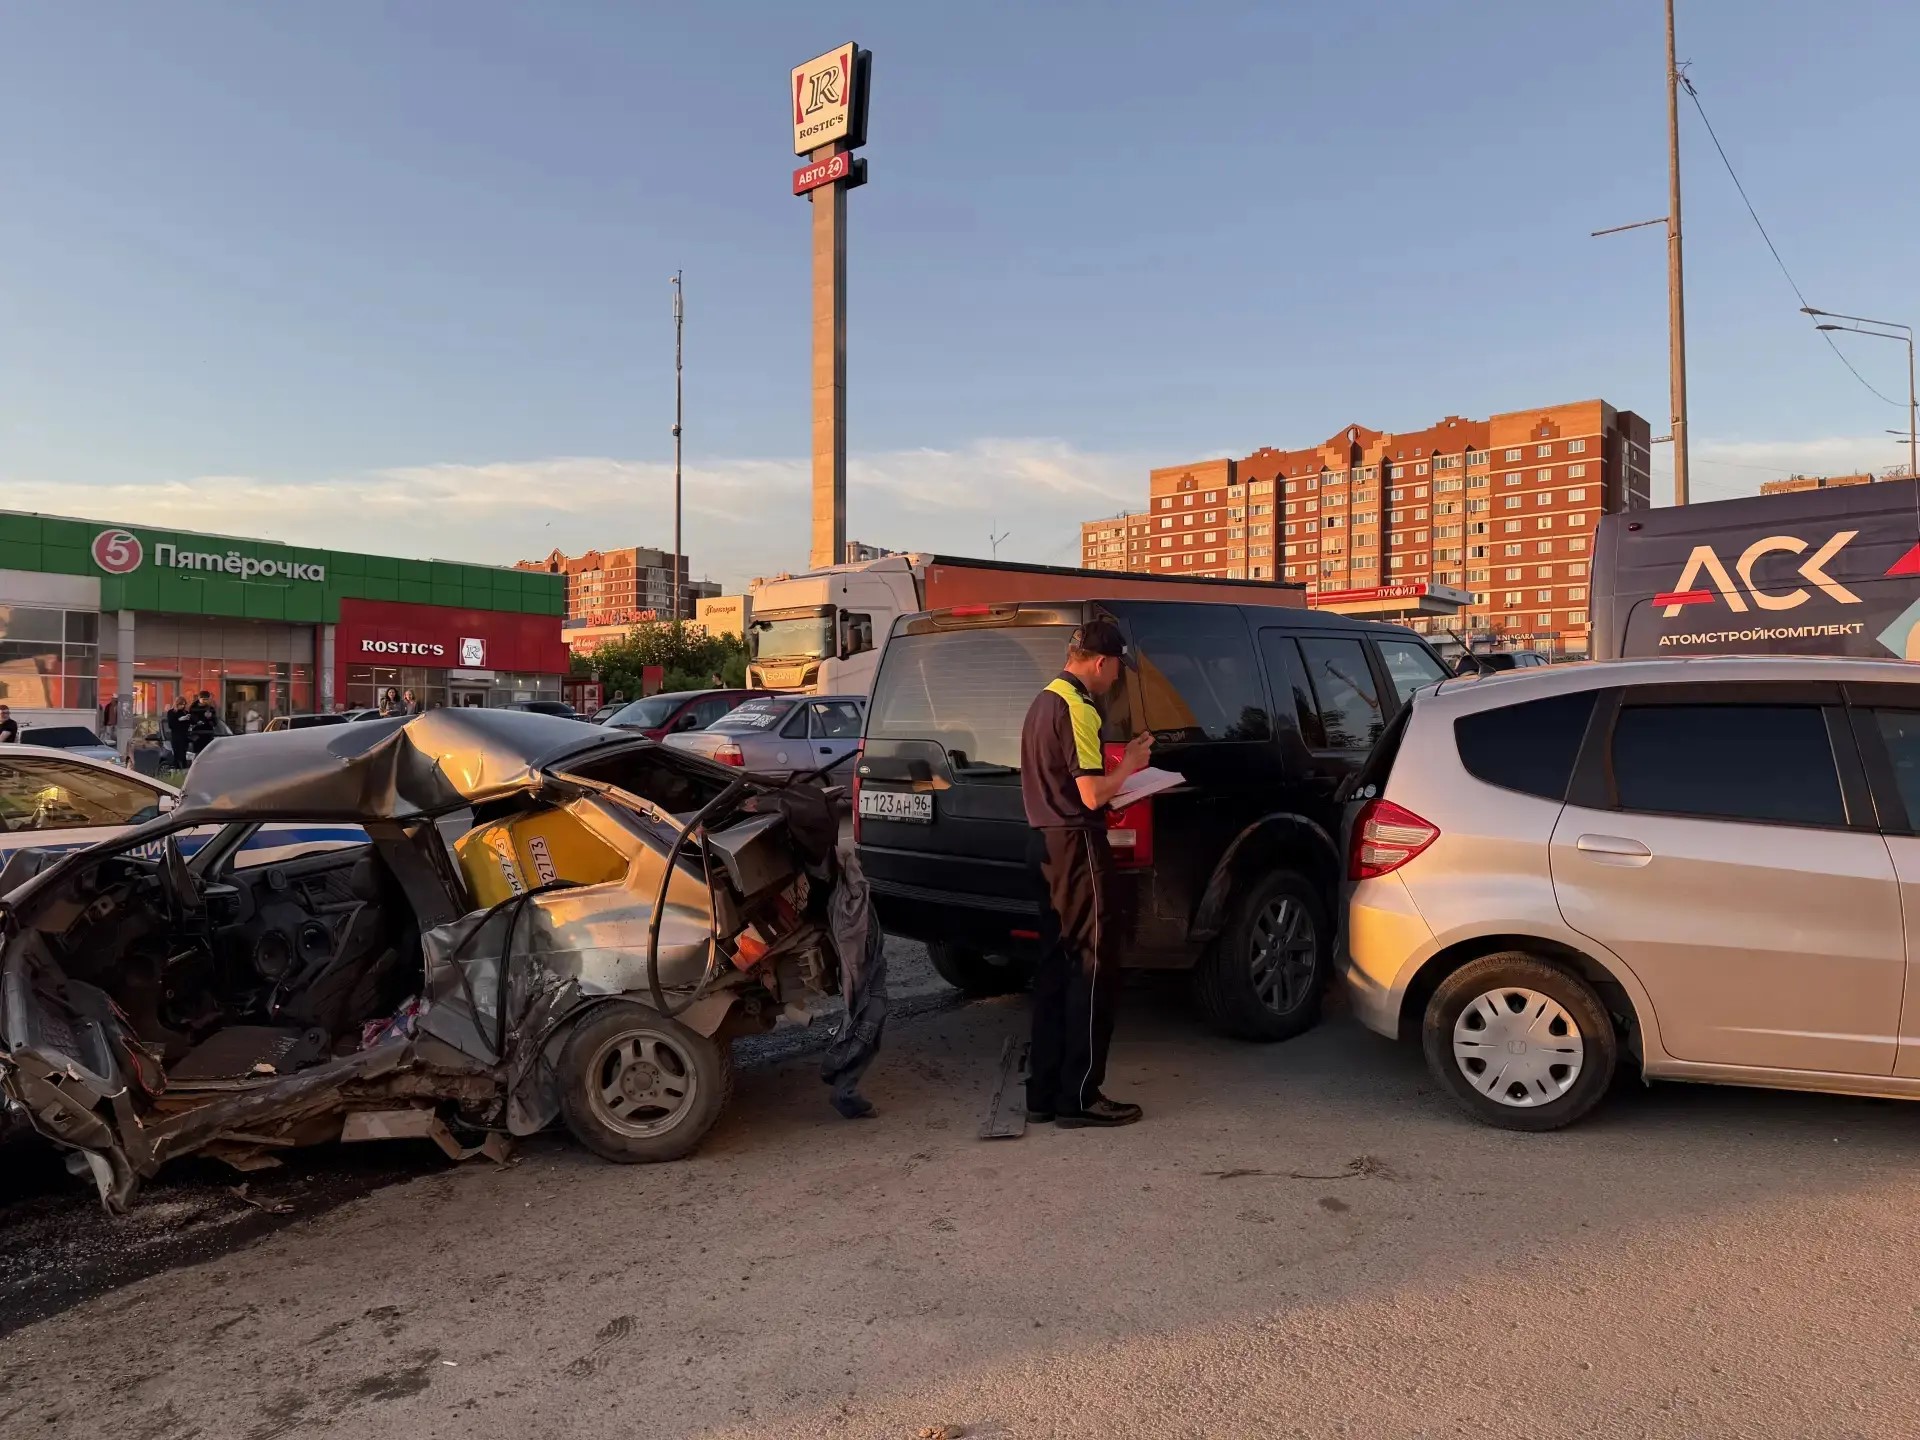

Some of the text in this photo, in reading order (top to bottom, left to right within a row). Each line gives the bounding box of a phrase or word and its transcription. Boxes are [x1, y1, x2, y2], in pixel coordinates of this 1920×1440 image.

[800, 114, 844, 139] ROSTIC'S
[798, 161, 840, 186] АВТО 24
[154, 543, 325, 582] Пятёрочка
[1652, 530, 1863, 618] АСК
[1376, 585, 1416, 597] ЛУКОЙЛ
[1659, 623, 1865, 646] АТОМСТРОЙКОМПЛЕКТ
[361, 640, 444, 656] ROSTIC'S
[914, 796, 927, 811] 96
[532, 841, 556, 887] 2773
